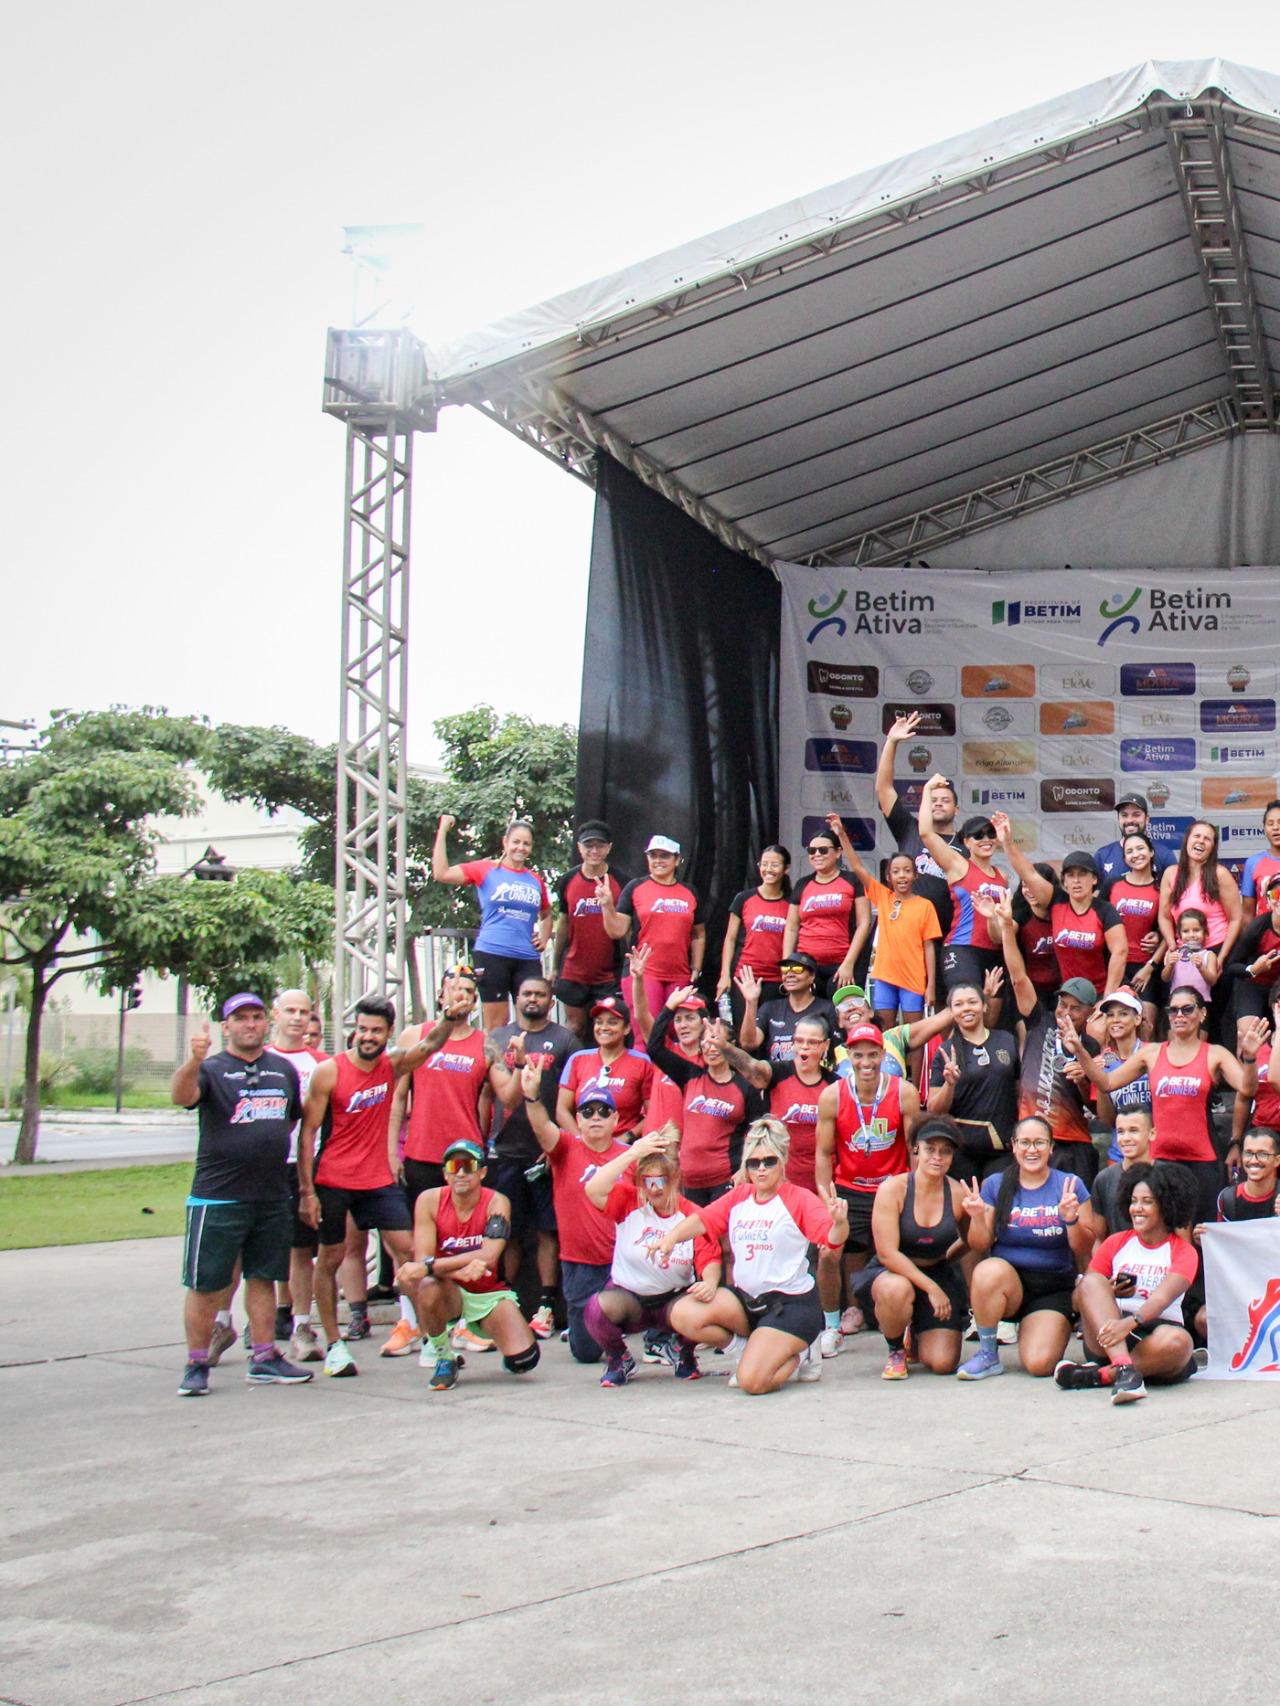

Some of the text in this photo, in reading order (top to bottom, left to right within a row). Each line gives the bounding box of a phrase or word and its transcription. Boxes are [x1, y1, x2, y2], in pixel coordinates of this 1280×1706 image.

[855, 590, 935, 612] Betim
[1150, 587, 1232, 609] Betim
[1024, 605, 1081, 617] BETIM
[854, 612, 922, 634] Ativa
[1148, 609, 1218, 632] Ativa
[907, 712, 942, 720] OONTO
[1216, 715, 1260, 725] MOURA
[1144, 744, 1175, 753] Betim
[1230, 749, 1265, 758] BETIM
[1144, 752, 1170, 761] Ativa
[991, 791, 1025, 800] BETIM
[1065, 787, 1100, 795] ODONTO
[1146, 822, 1176, 832] Betim
[1231, 828, 1265, 836] BETIM
[816, 893, 843, 902] BETIM
[664, 899, 688, 908] BETIM
[1126, 898, 1154, 909] BETIM
[1067, 931, 1096, 942] BETIM
[444, 1053, 475, 1065] BETIM
[1121, 1080, 1148, 1094] BETI
[1168, 1076, 1201, 1087] BETIM
[363, 1082, 388, 1099] BETIM
[251, 1097, 289, 1108] BETIM
[704, 1097, 735, 1112] BETIM
[1020, 1205, 1059, 1217] BETIM
[744, 1243, 774, 1261] 3 anos
[1131, 1263, 1168, 1277] BETIM
